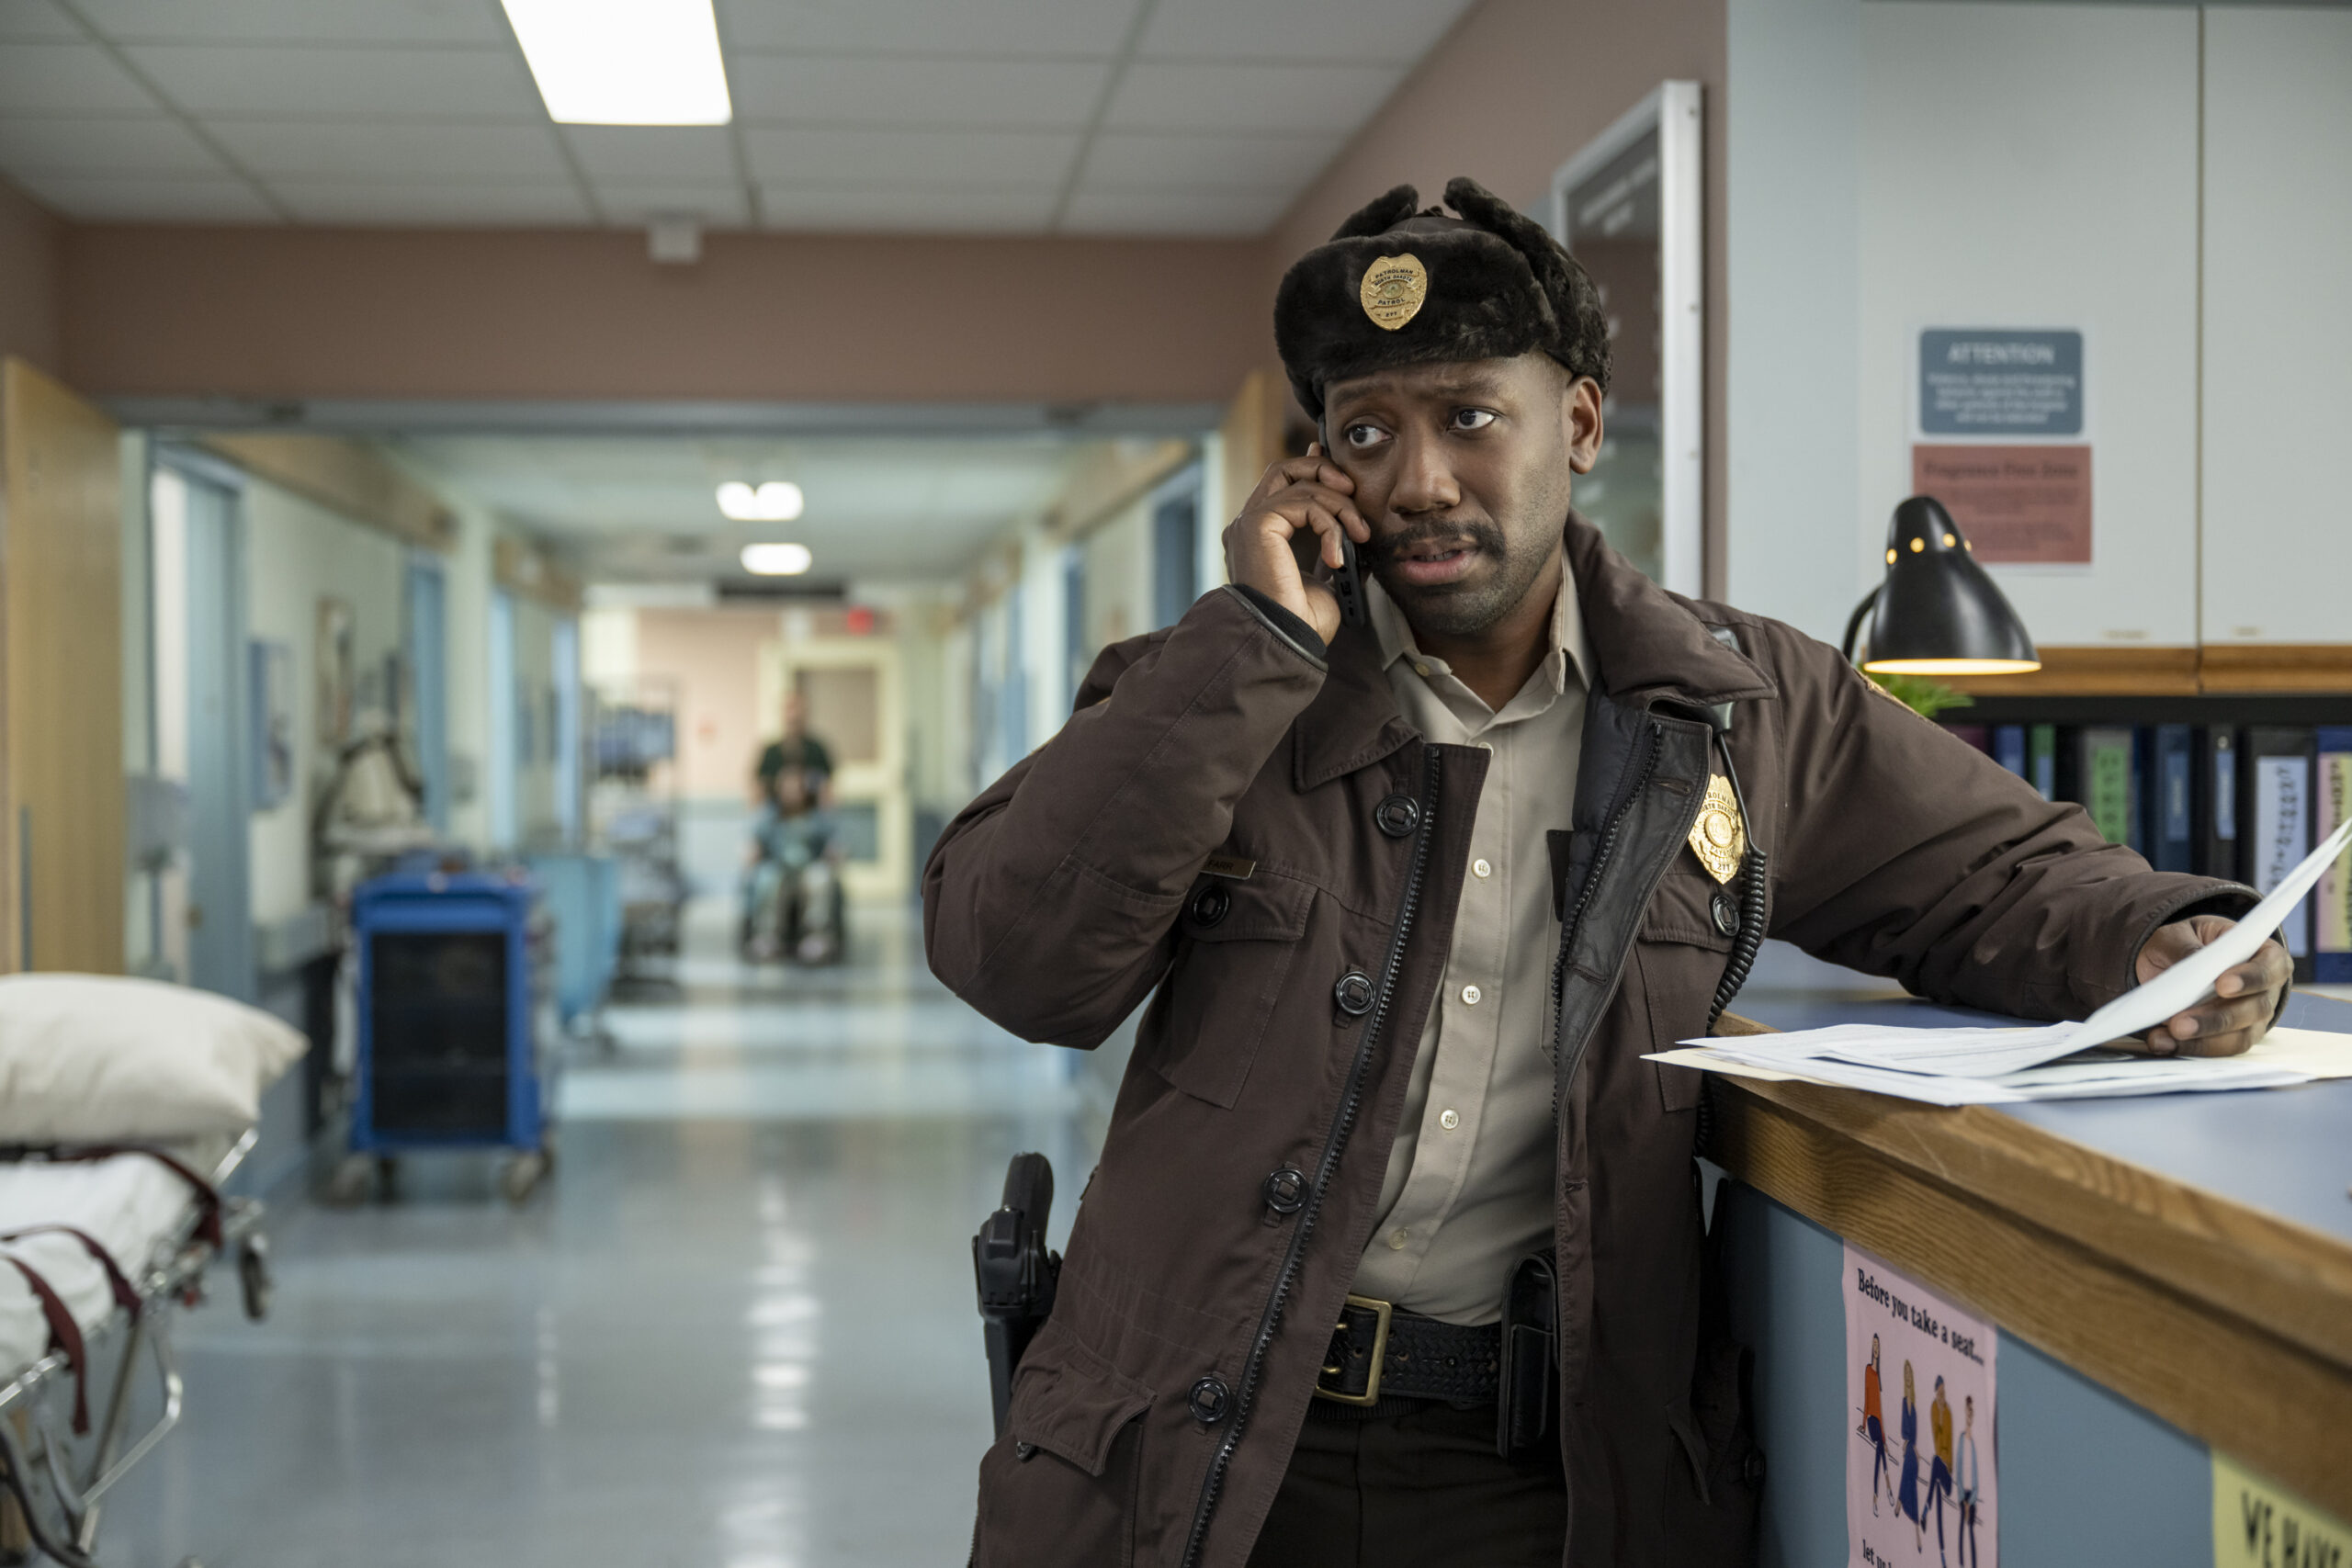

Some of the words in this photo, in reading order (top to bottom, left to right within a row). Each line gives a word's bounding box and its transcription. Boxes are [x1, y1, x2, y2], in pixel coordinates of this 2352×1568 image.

[1374, 276, 1391, 286] NORTH
[1375, 268, 1414, 278] PATROLMAN
[1705, 791, 1735, 807] ROLMAN
[1857, 1268, 1890, 1308] Before
[1891, 1293, 1908, 1323] you
[1911, 1305, 1939, 1338] take
[1941, 1325, 1948, 1345] a
[1862, 1539, 1875, 1566] let
